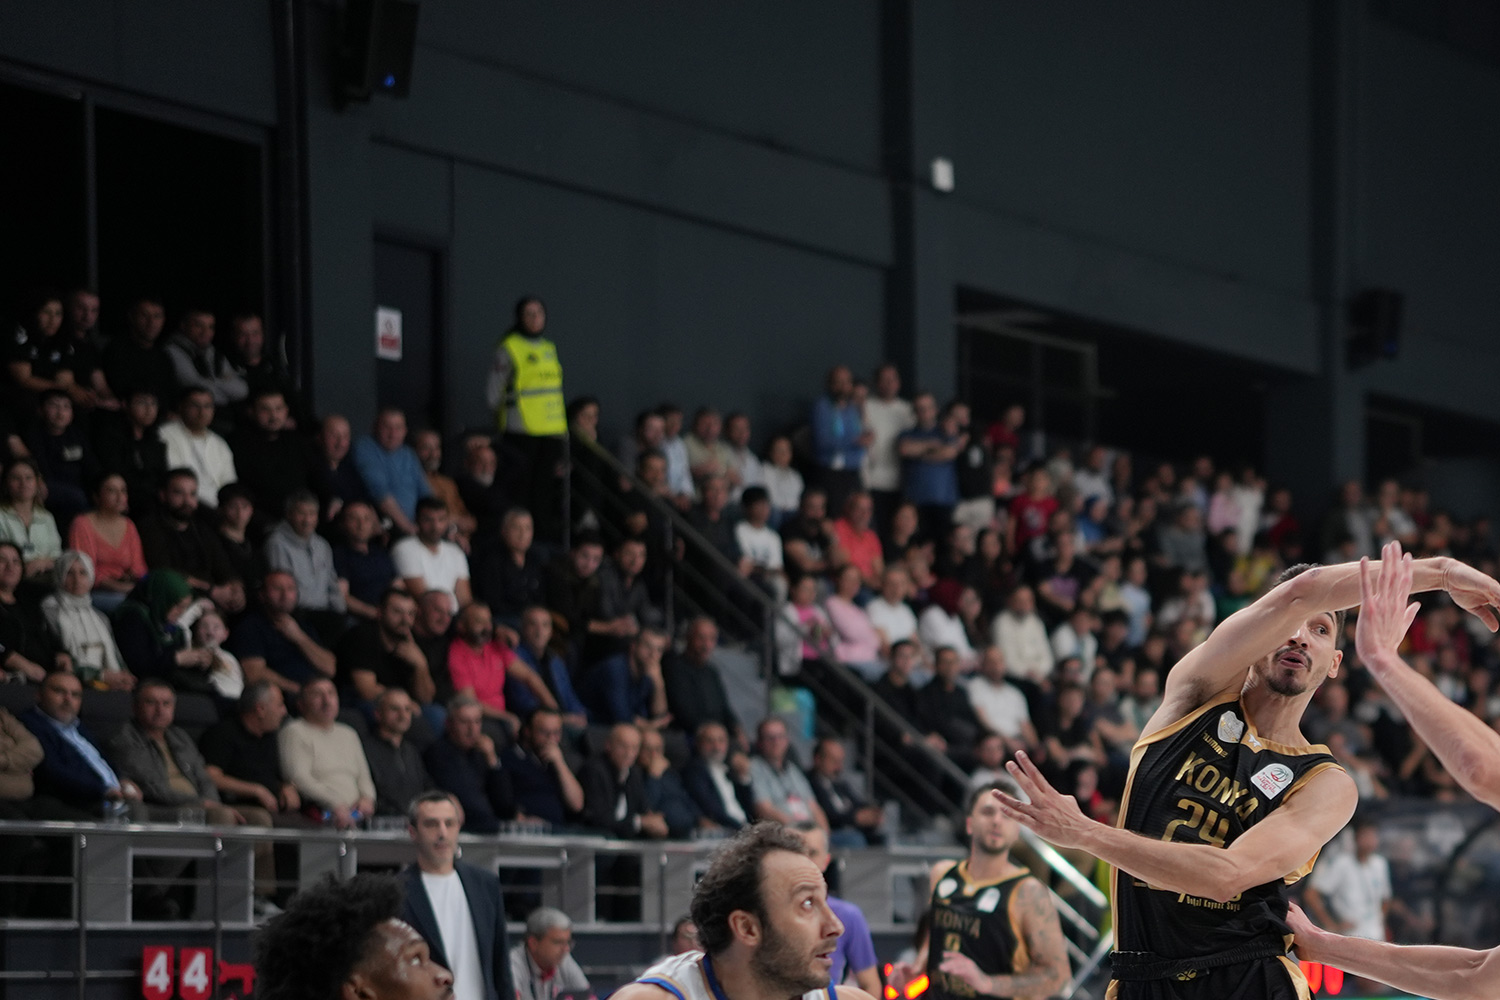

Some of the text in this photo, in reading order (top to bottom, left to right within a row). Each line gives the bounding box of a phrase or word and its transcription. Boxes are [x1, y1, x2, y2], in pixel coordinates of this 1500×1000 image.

[1175, 751, 1260, 822] KONYA
[1161, 798, 1231, 849] 24
[145, 951, 171, 994] 4
[183, 951, 209, 994] 4
